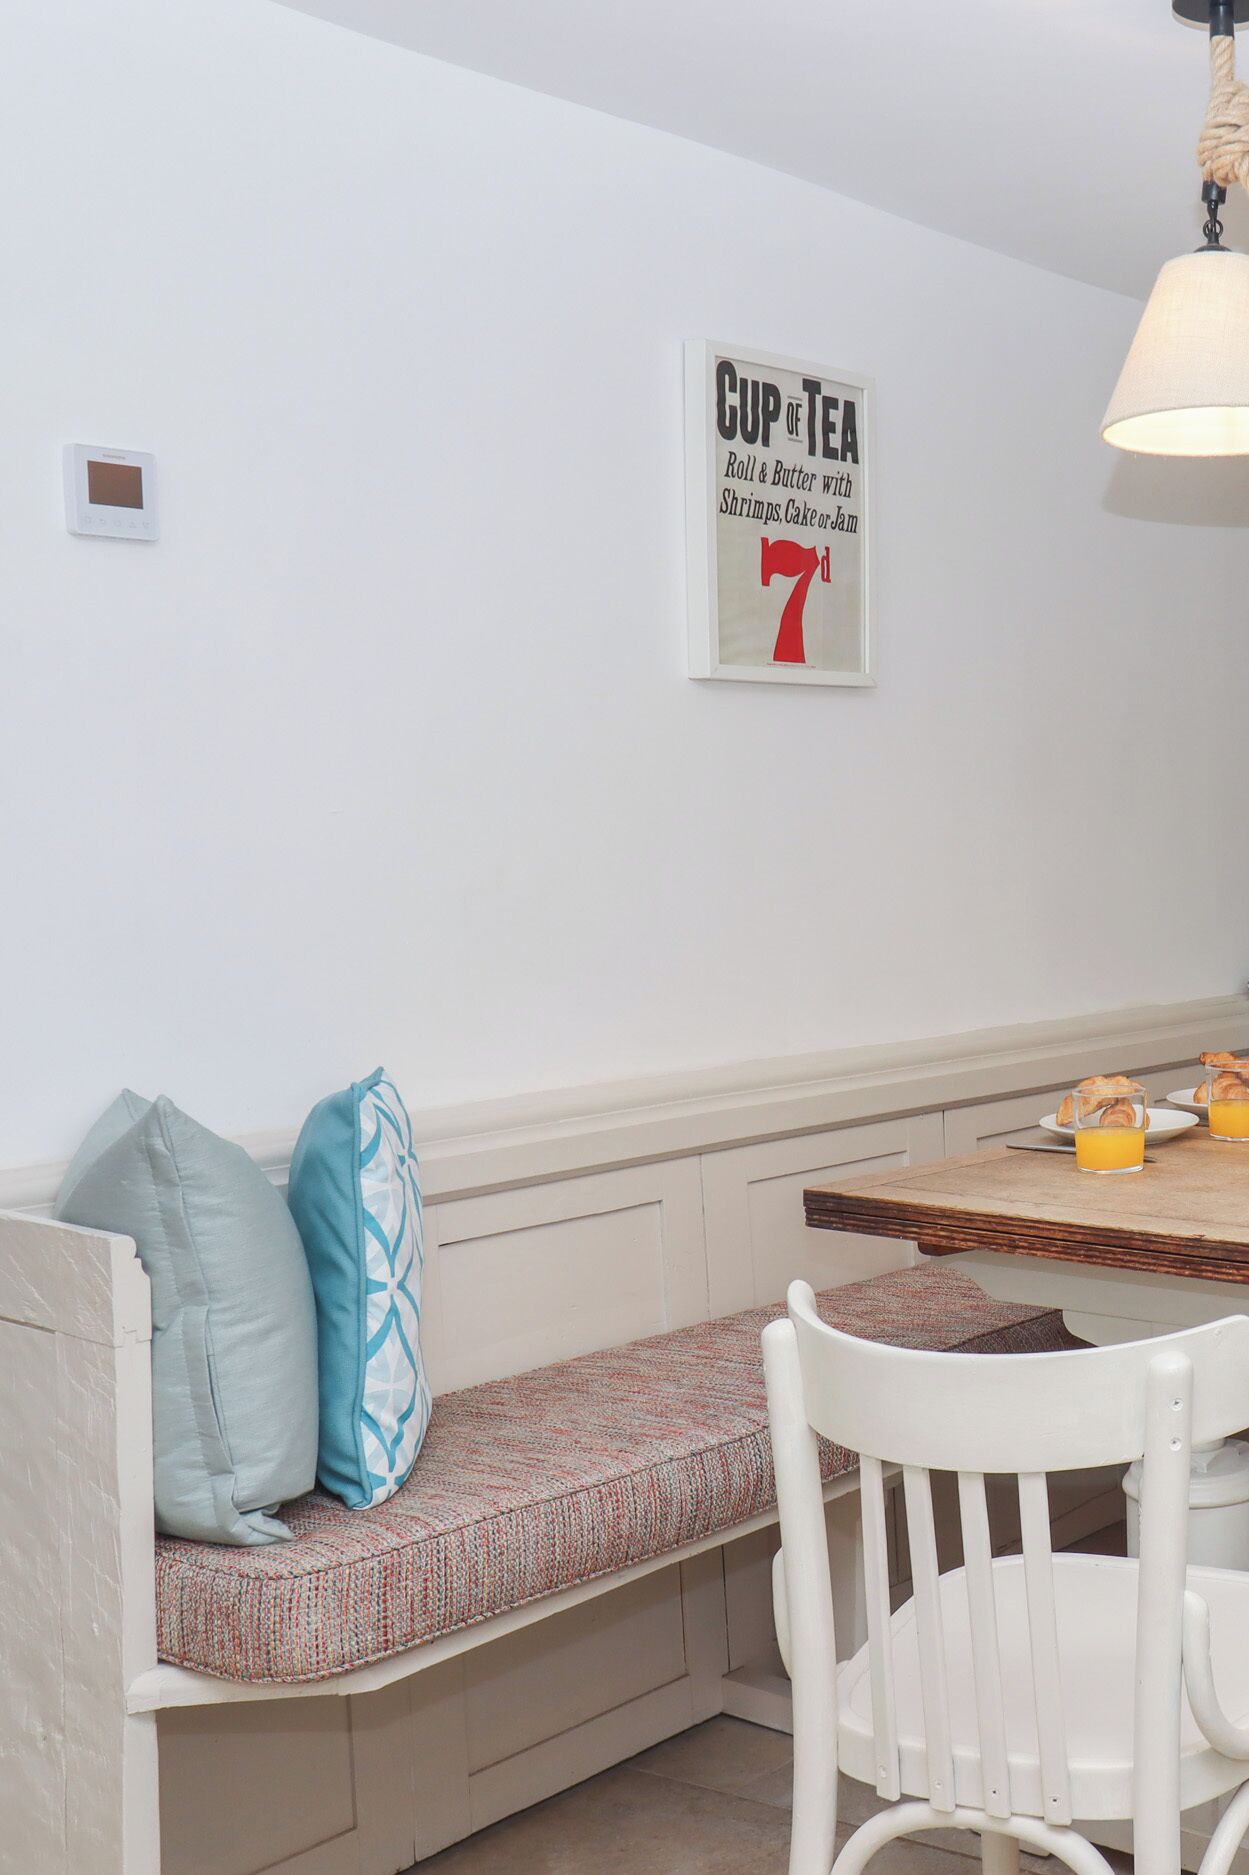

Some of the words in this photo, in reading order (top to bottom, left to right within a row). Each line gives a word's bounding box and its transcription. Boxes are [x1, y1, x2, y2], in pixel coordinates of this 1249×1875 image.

[716, 360, 781, 447] CUP
[786, 401, 802, 437] OF
[802, 378, 859, 464] TEA
[724, 451, 757, 481] Roll
[758, 462, 768, 484] &
[770, 460, 816, 491] Butter
[822, 470, 853, 498] with
[719, 488, 783, 525] Shrimps,
[784, 498, 818, 527] Cake
[817, 512, 831, 529] or
[830, 505, 859, 533] Jam
